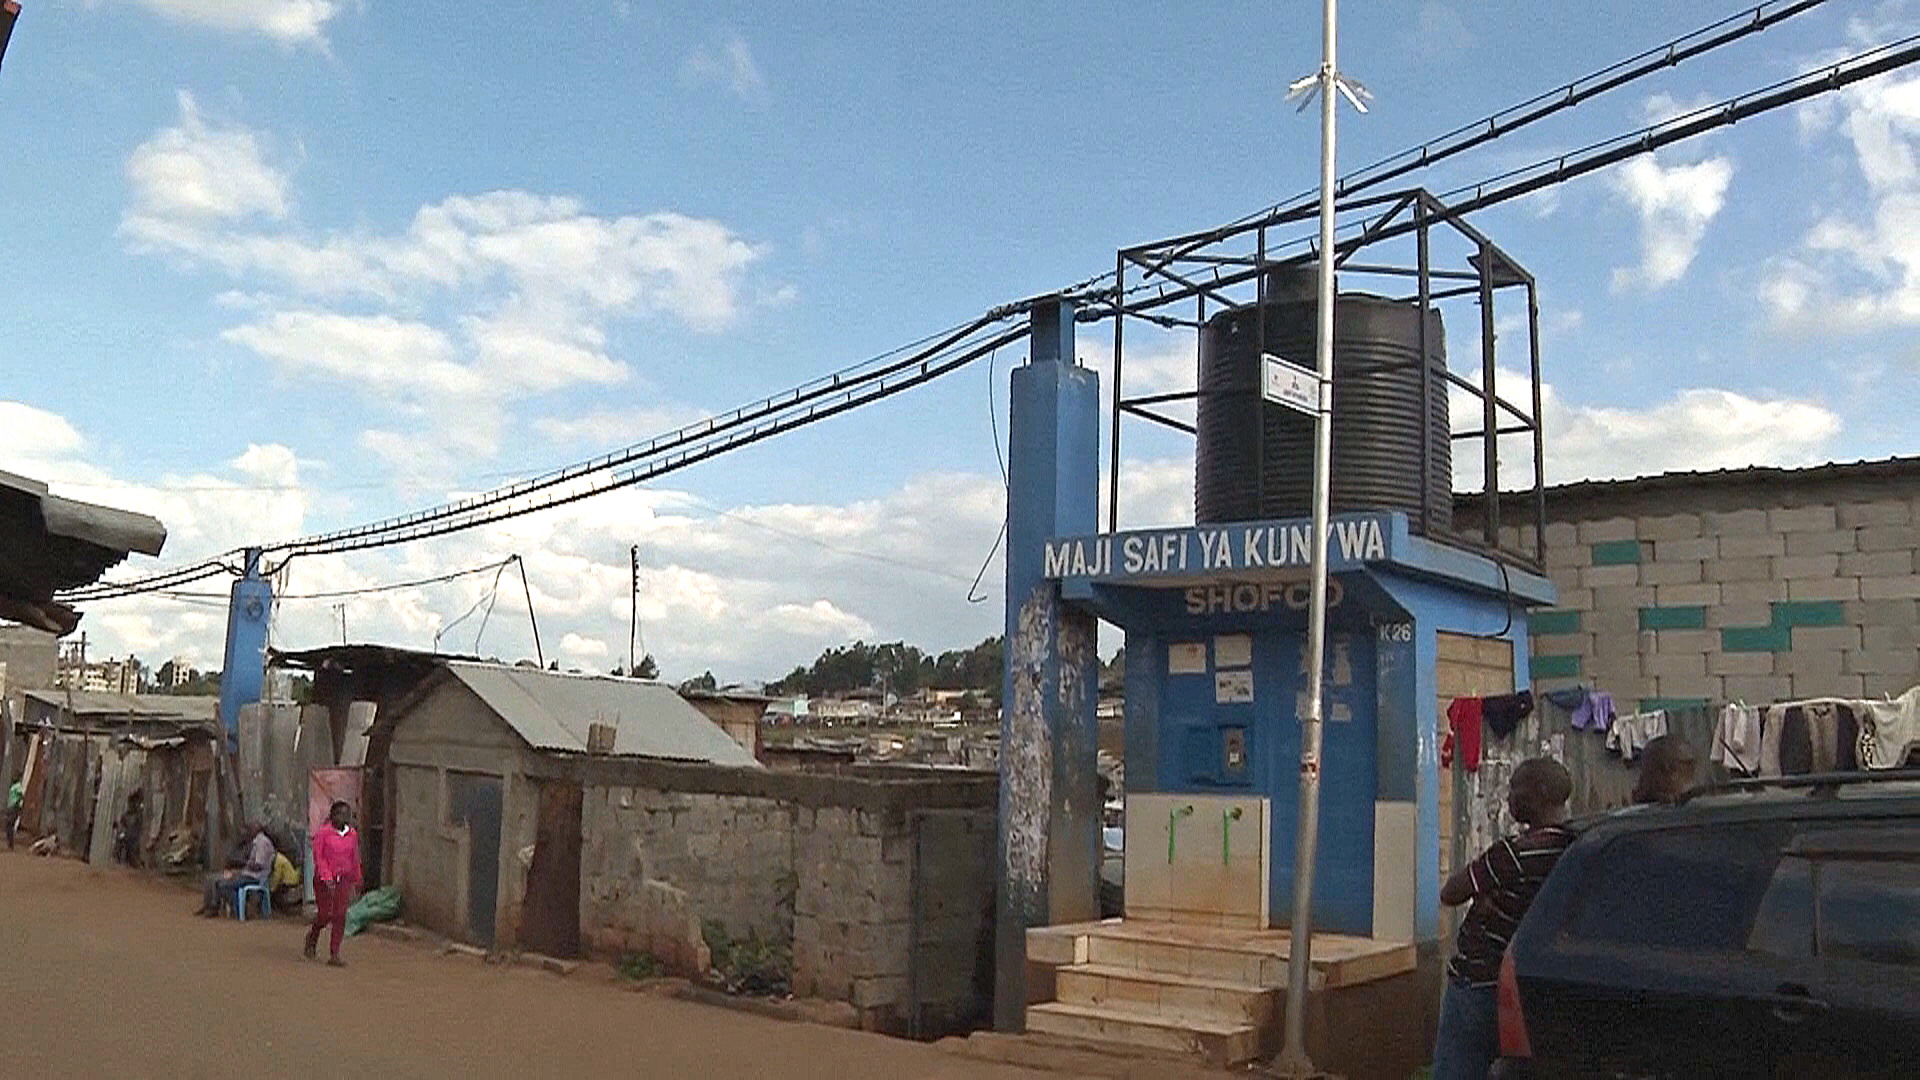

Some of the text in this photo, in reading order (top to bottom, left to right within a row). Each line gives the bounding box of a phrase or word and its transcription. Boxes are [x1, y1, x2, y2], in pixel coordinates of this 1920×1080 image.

[1044, 520, 1385, 578] MAJI SAFI YA KUNWA
